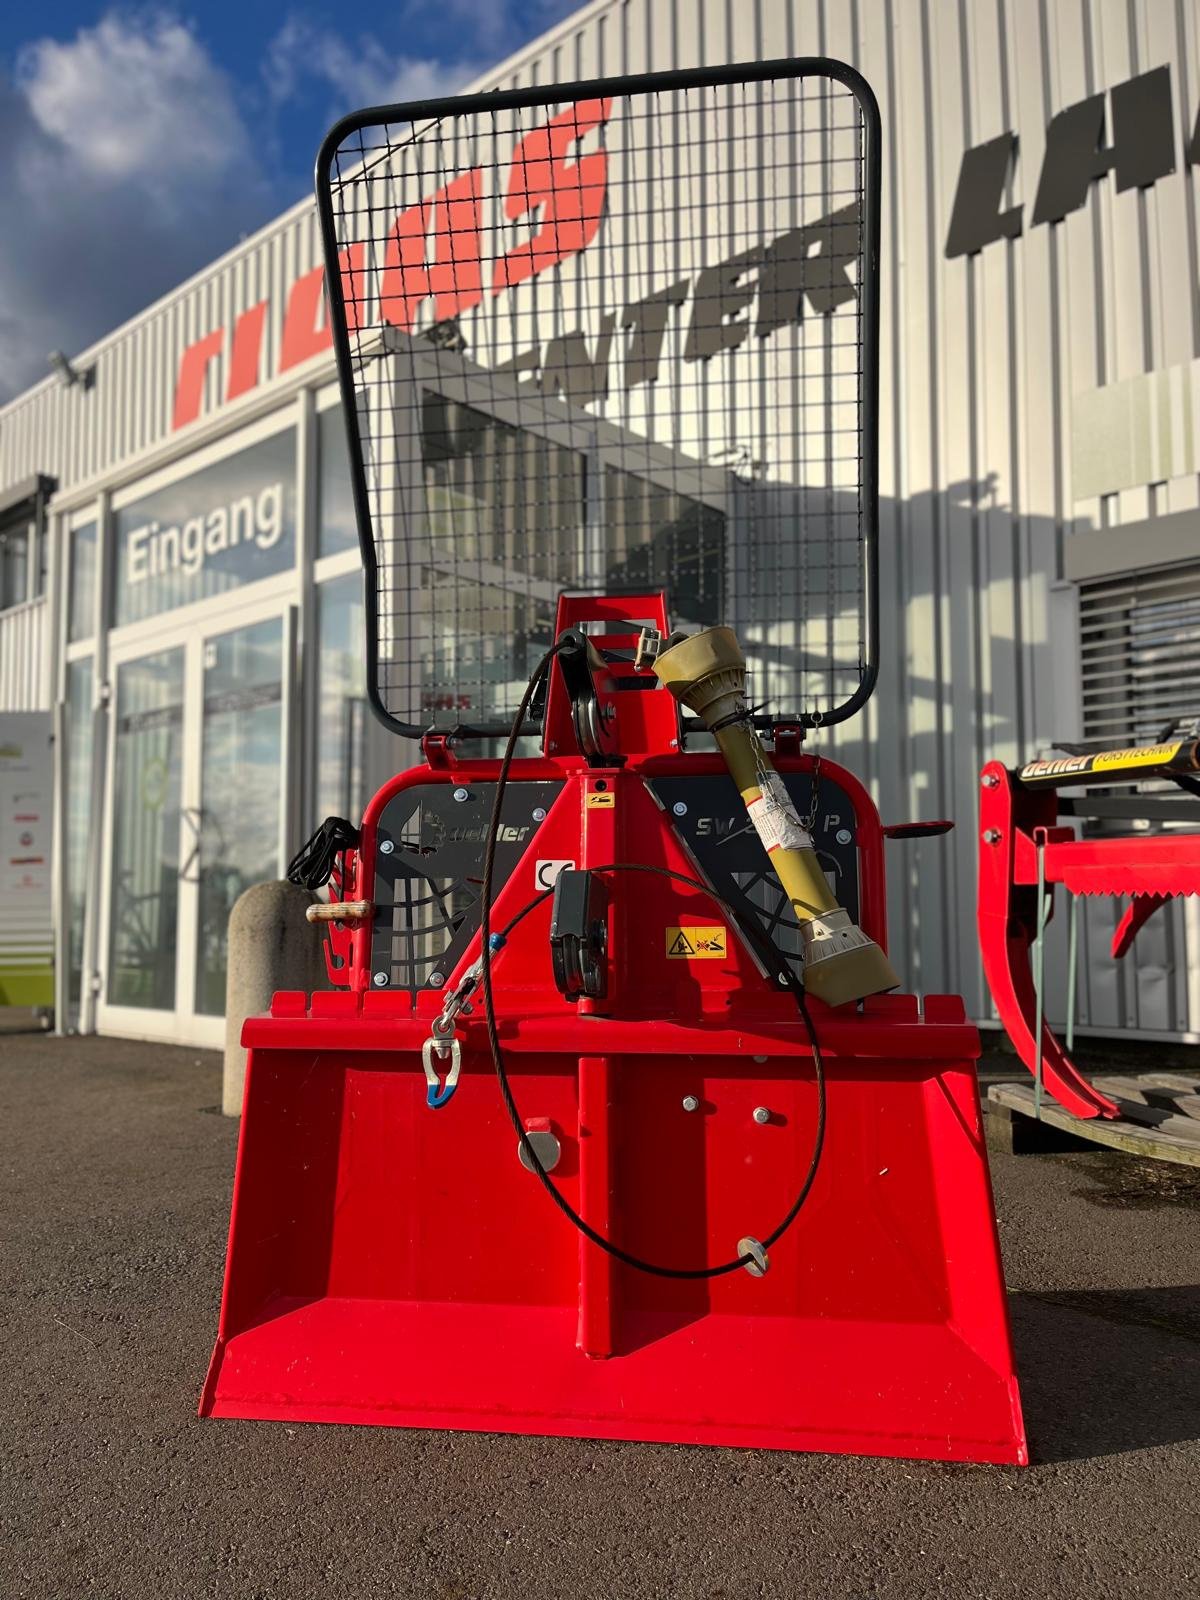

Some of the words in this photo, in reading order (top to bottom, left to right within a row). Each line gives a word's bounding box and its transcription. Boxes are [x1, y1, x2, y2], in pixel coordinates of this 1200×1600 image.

[944, 62, 1200, 260] LA
[127, 483, 283, 584] Eingang
[1096, 742, 1174, 763] FORSTTECHNIK
[823, 814, 841, 833] P
